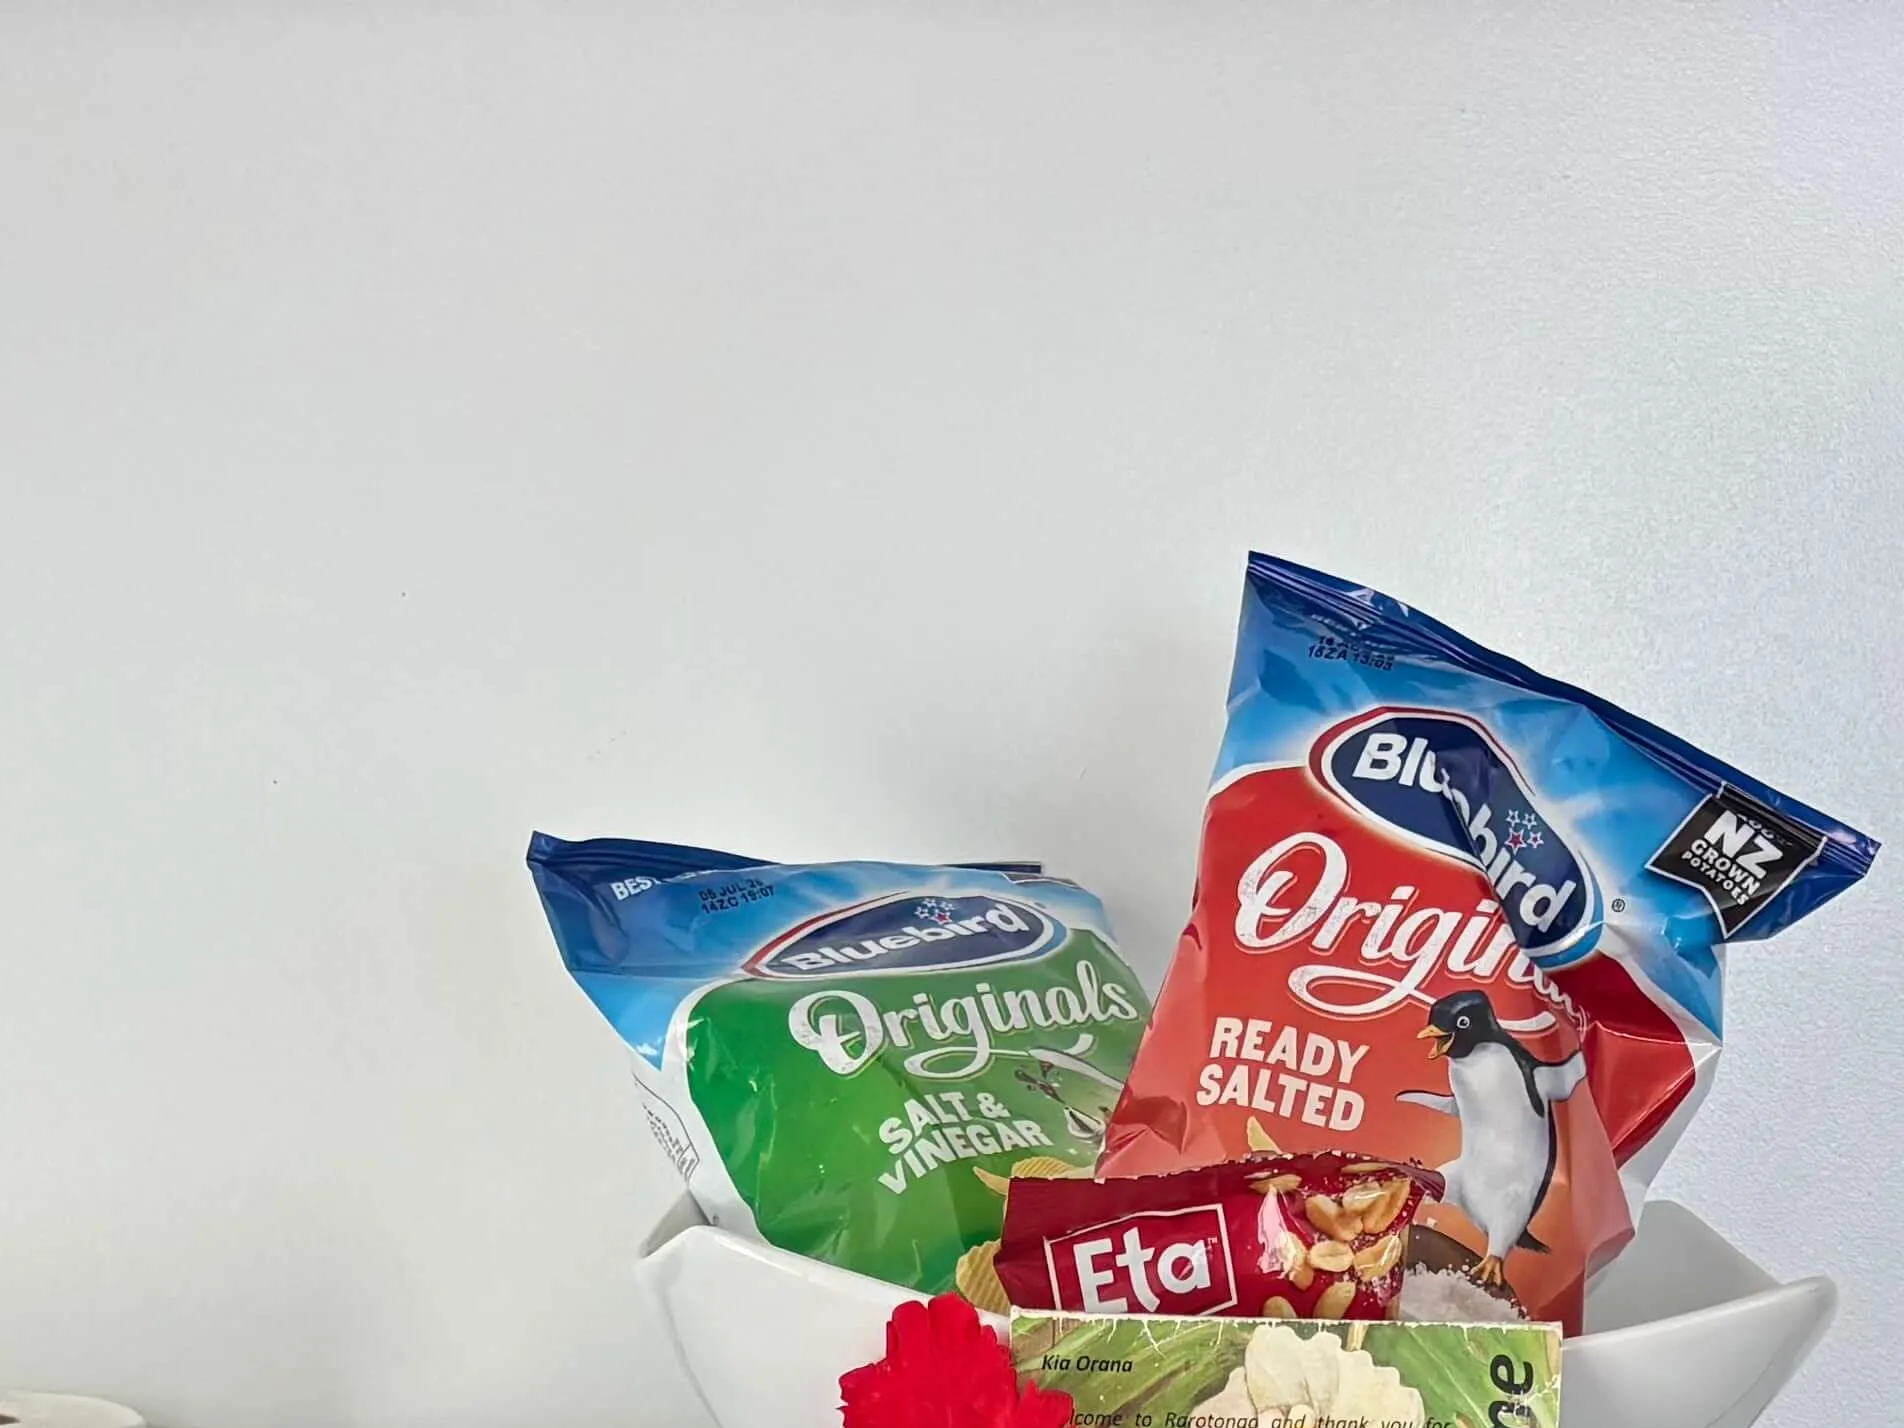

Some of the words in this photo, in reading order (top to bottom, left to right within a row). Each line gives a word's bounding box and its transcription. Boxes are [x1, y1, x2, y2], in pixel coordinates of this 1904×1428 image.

[1681, 852, 1750, 905] POTATOES
[1691, 840, 1762, 896] GROWN
[1704, 810, 1783, 880] NZ
[720, 882, 745, 896] JUL
[781, 904, 1030, 972] Bluebird
[789, 960, 1138, 1079] Originals
[1208, 1017, 1369, 1084] READY
[879, 1092, 973, 1155] SALT
[976, 1092, 1010, 1119] &
[1196, 1064, 1366, 1132] SALTED
[878, 1120, 1054, 1194] VINEGAR
[1075, 1225, 1214, 1314] Eta
[1042, 1355, 1071, 1371] Kia
[1076, 1356, 1133, 1373] Orana
[1135, 1413, 1152, 1427] to
